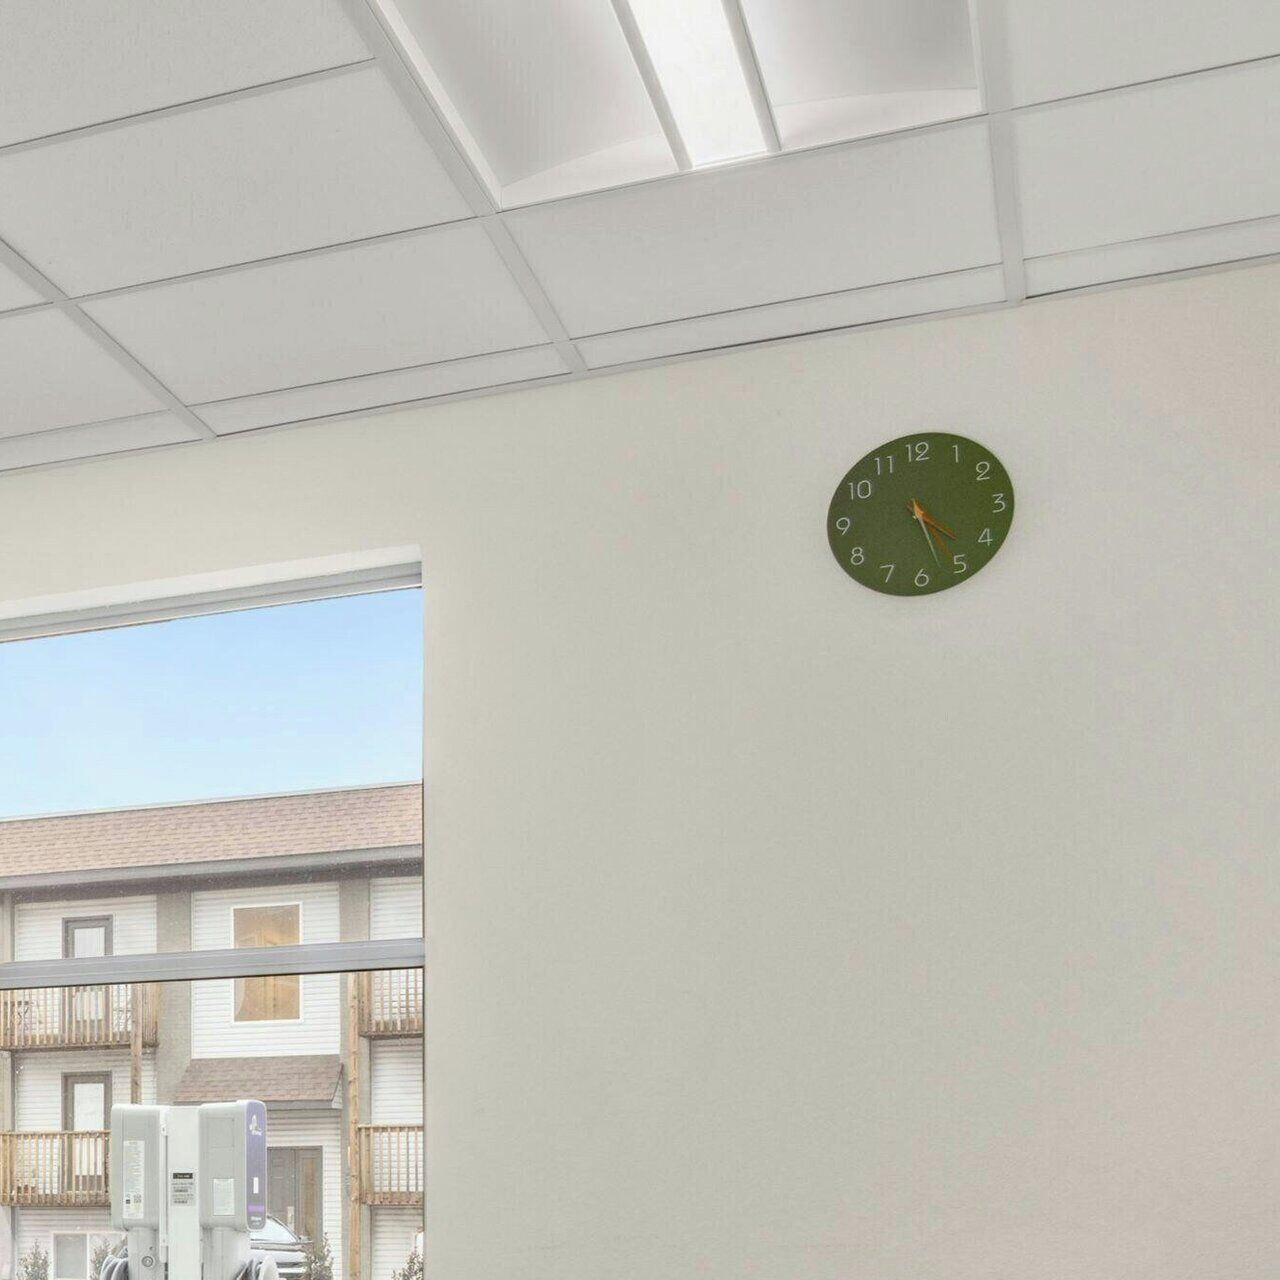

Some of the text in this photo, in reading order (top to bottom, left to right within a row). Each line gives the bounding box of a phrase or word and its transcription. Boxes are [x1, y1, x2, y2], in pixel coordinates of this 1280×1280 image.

[905, 441, 930, 462] 12
[951, 444, 960, 463] 1
[874, 455, 894, 475] 11
[975, 461, 990, 481] 2
[848, 479, 872, 500] 10
[992, 493, 1006, 513] 3
[836, 517, 850, 536] 9
[977, 528, 993, 546] 4
[850, 546, 864, 566] 8
[953, 554, 967, 574] 5
[879, 564, 895, 584] 7
[914, 568, 930, 587] 6
